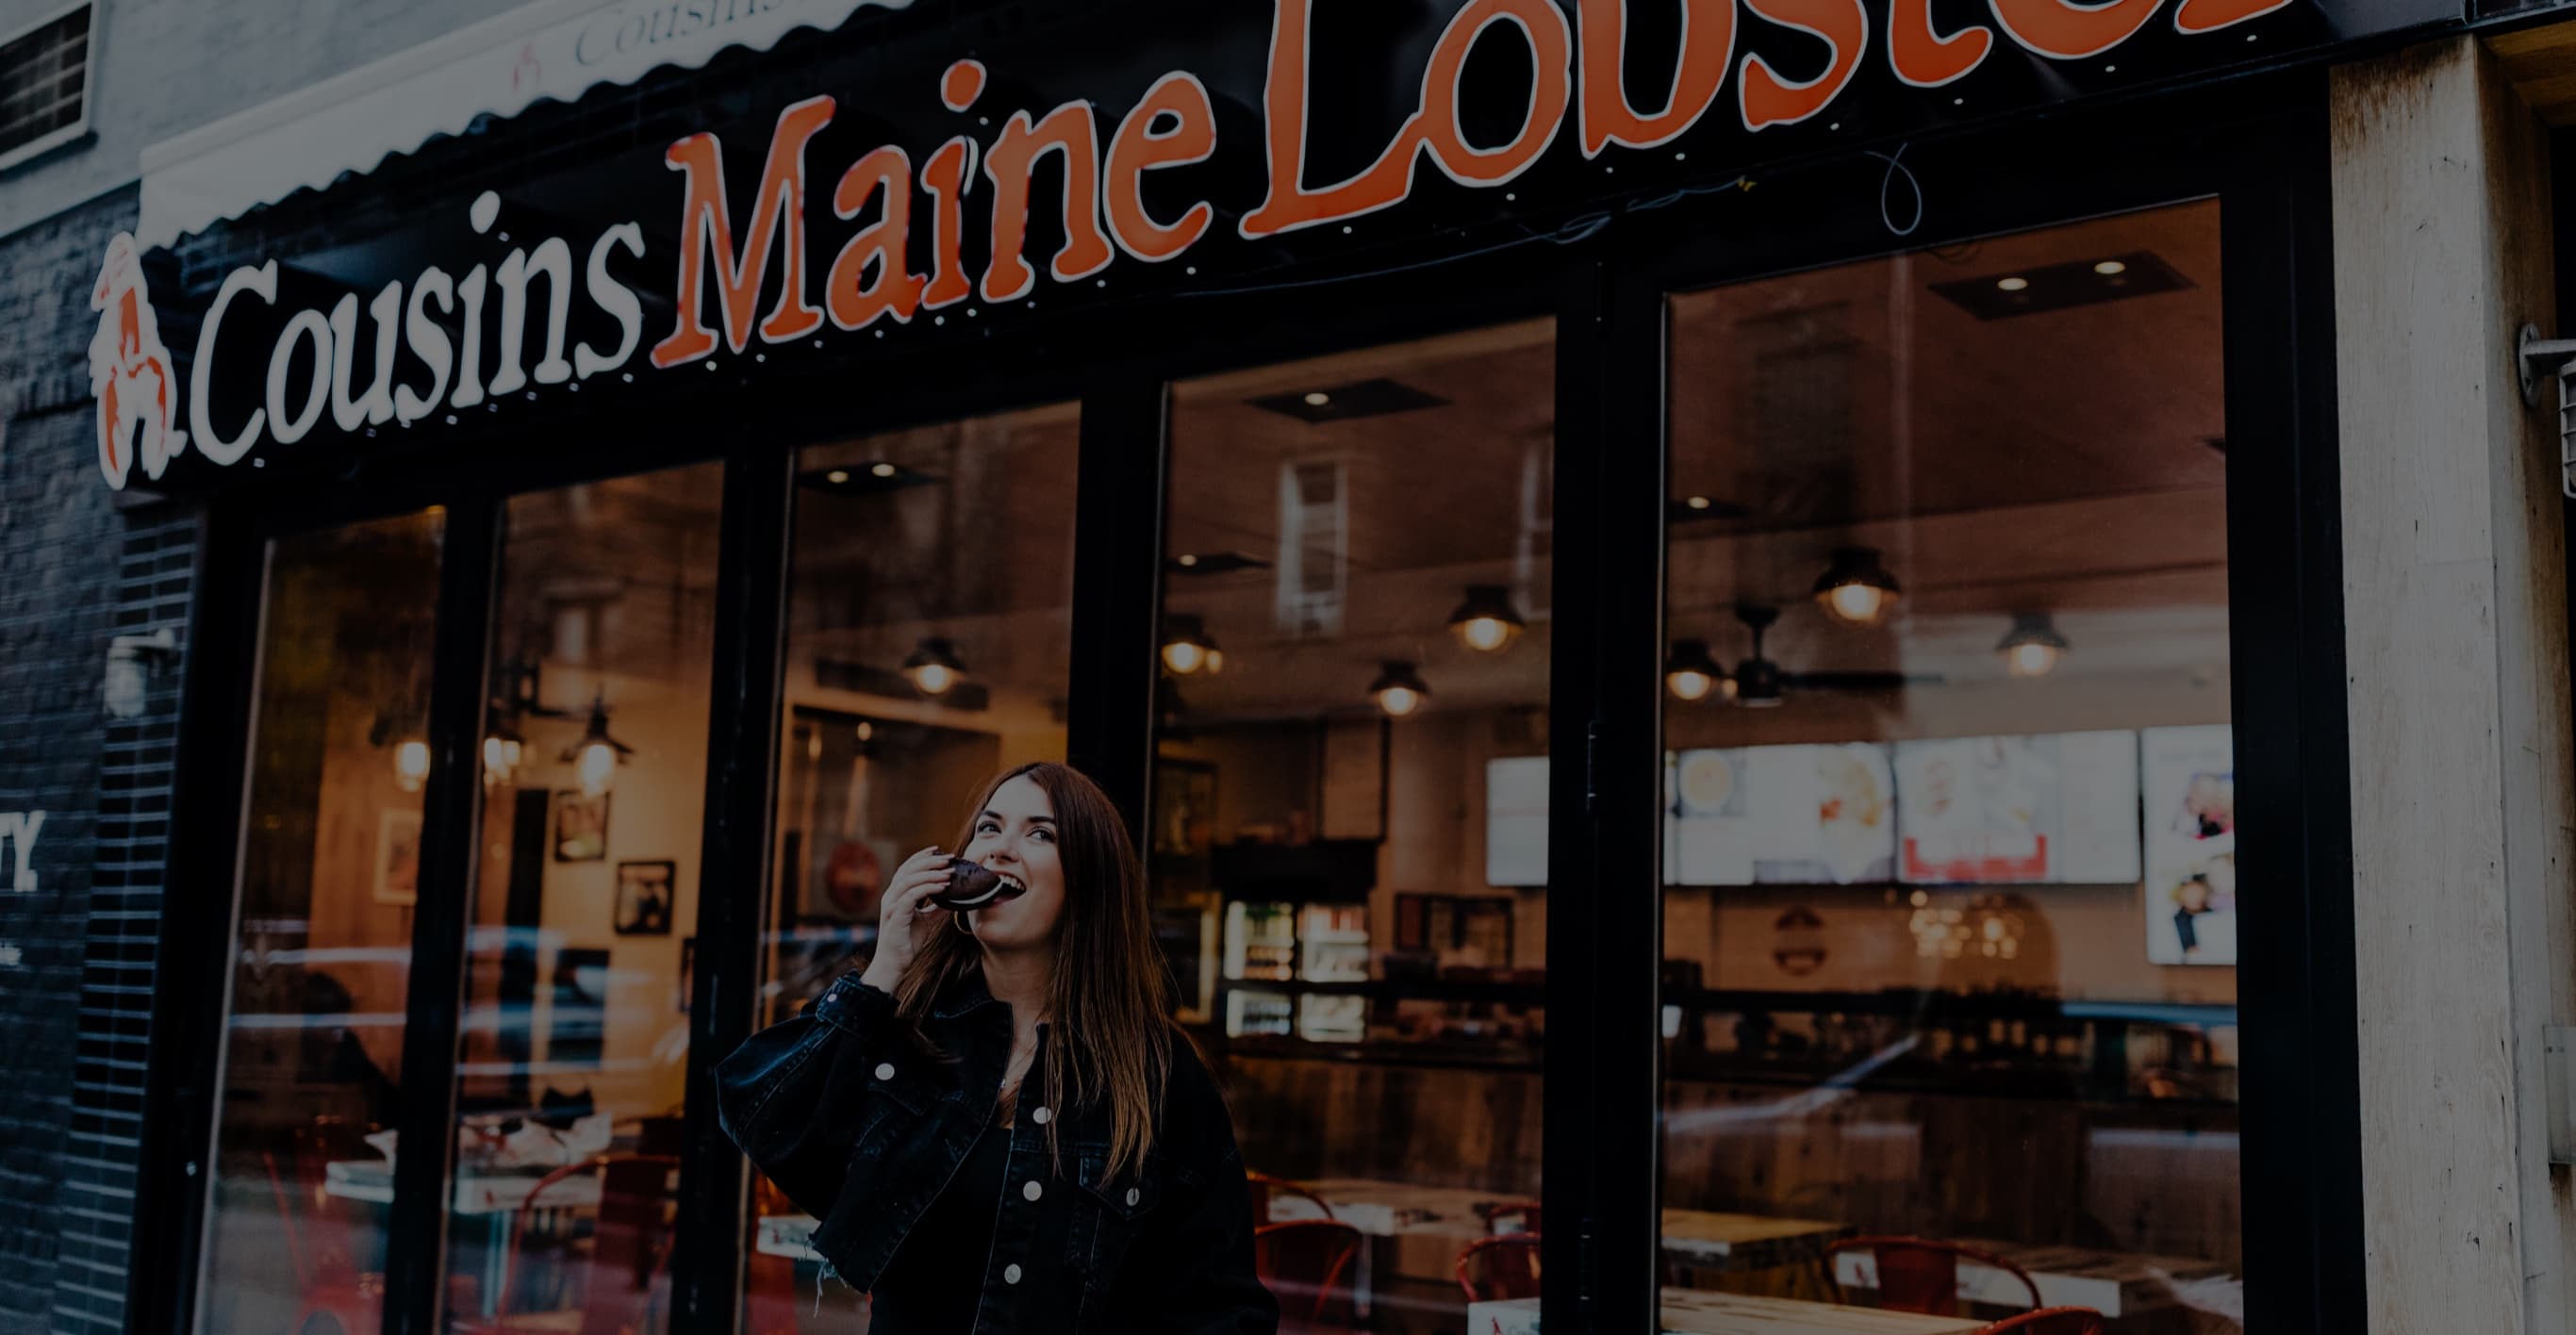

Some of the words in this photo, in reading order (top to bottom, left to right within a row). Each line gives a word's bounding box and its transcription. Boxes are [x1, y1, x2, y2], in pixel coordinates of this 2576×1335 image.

[190, 190, 646, 467] Cousins
[651, 58, 1216, 369] Maine
[1238, 0, 2295, 239] Lobs
